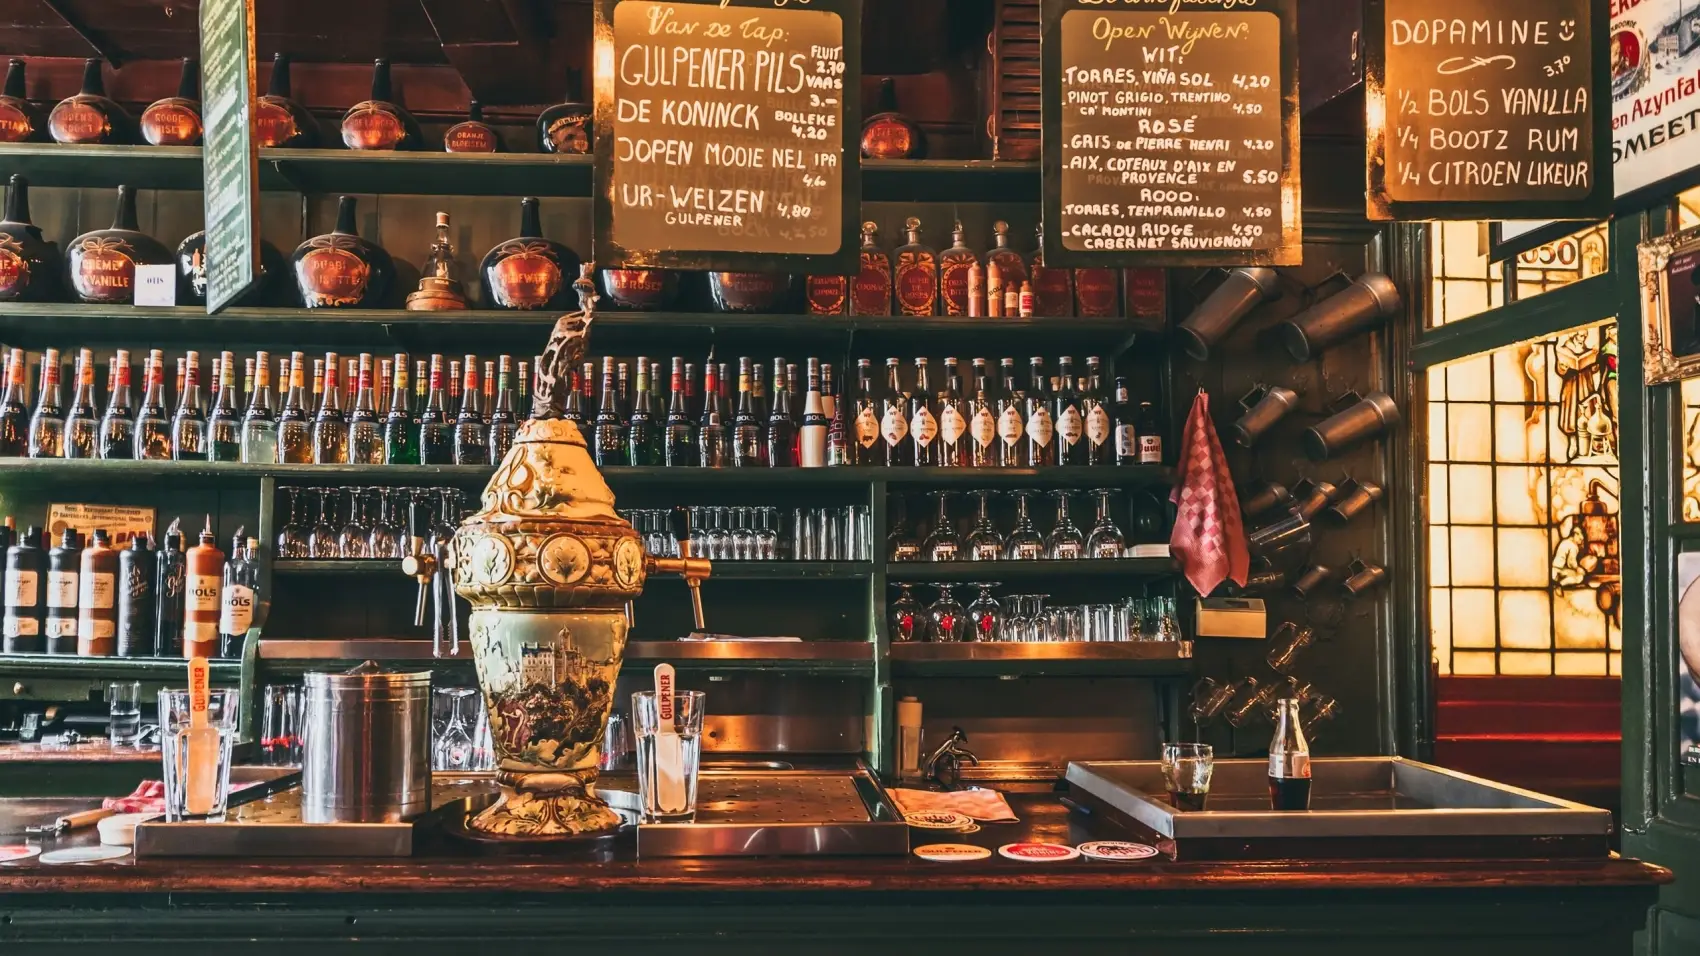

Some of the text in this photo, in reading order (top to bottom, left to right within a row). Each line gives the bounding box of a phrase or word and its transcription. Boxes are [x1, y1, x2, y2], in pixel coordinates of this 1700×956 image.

[646, 5, 700, 37] Van
[1092, 17, 1155, 51] Open
[1391, 19, 1550, 46] DOPAMINE
[810, 45, 843, 61] FLUIT
[620, 44, 806, 94] GULPENER PILS
[1142, 67, 1176, 85] VIÑA
[1180, 72, 1214, 87] SOL
[805, 75, 843, 90] VAAS
[1067, 90, 1109, 104] PINOT
[1171, 92, 1231, 103] TRENTINO
[1428, 88, 1490, 116] BOLS
[1501, 87, 1588, 117] VANILLA
[617, 98, 760, 131] DE KONINCK
[774, 110, 836, 127] BOLLEKE
[1102, 106, 1151, 117] MONTINI
[1138, 115, 1198, 134] ROSÉ
[1612, 113, 1628, 130] en
[1071, 134, 1111, 150] GRIS
[1135, 137, 1182, 151] PIERRE
[1189, 139, 1230, 151] HENRI
[1429, 128, 1509, 151] BOOTZ
[1528, 128, 1578, 152] RUM
[617, 137, 837, 170] JOPEN MOOIE NEL IPA
[1107, 157, 1168, 171] COTEAUX
[1173, 159, 1211, 173] D'AIX
[1217, 160, 1236, 173] EN
[1121, 172, 1198, 185] PROVENCE
[1428, 160, 1521, 187] CITROEN
[1526, 161, 1589, 188] LIKEUR
[665, 211, 743, 227] GULPENER
[1127, 204, 1226, 218] TEMPRANILLO
[1071, 223, 1194, 238] CACADU RIDGE
[1084, 236, 1254, 249] CABERNET SAUVIGNON
[3, 406, 20, 414] OLS
[40, 406, 59, 415] OLS
[107, 406, 126, 415] OLS
[179, 408, 197, 416] OLS
[214, 408, 232, 416] OLS
[248, 408, 266, 416] OLS
[193, 667, 205, 713] GULPENER
[660, 674, 673, 720] GULPENER
